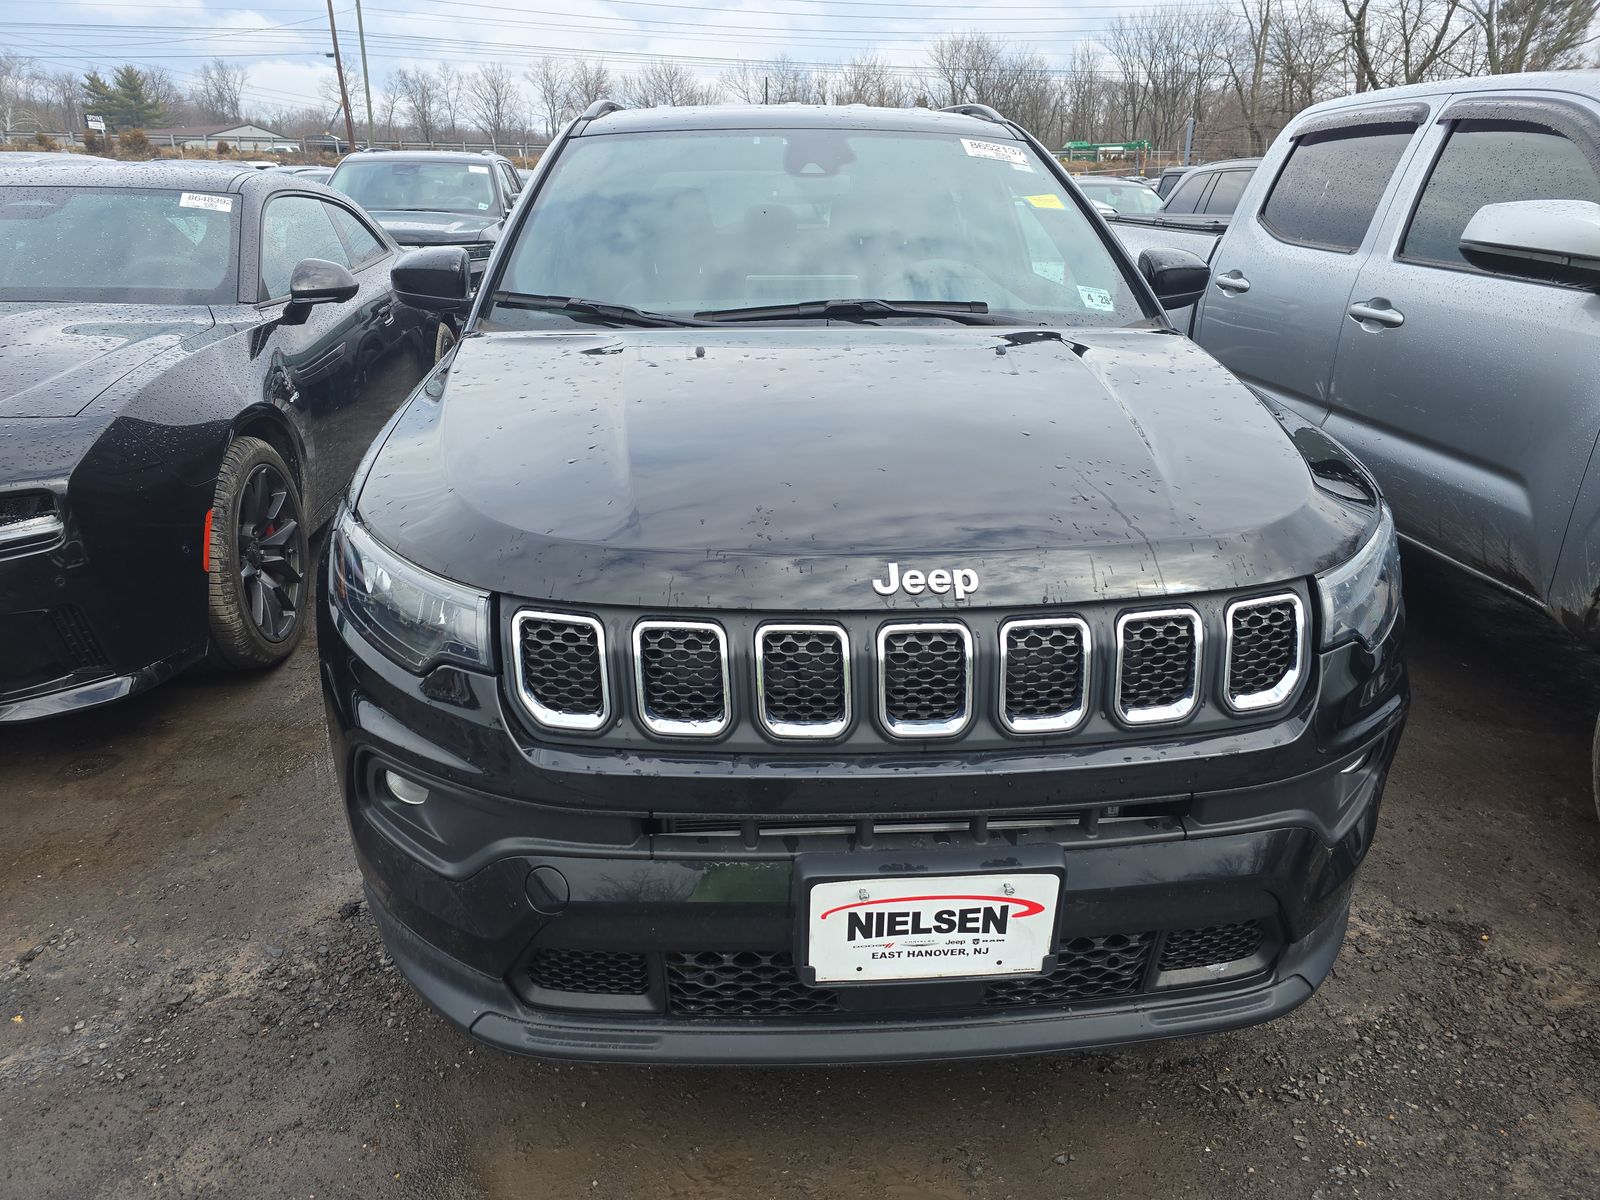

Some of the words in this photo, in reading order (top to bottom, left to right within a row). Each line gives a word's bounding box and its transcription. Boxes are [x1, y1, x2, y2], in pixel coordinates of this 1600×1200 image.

[1087, 293, 1094, 303] 4
[871, 562, 980, 601] Jeep
[847, 904, 1010, 942] NIELSEN
[871, 950, 903, 960] EAST
[907, 948, 969, 958] HANOVER,
[973, 947, 989, 956] NJ
